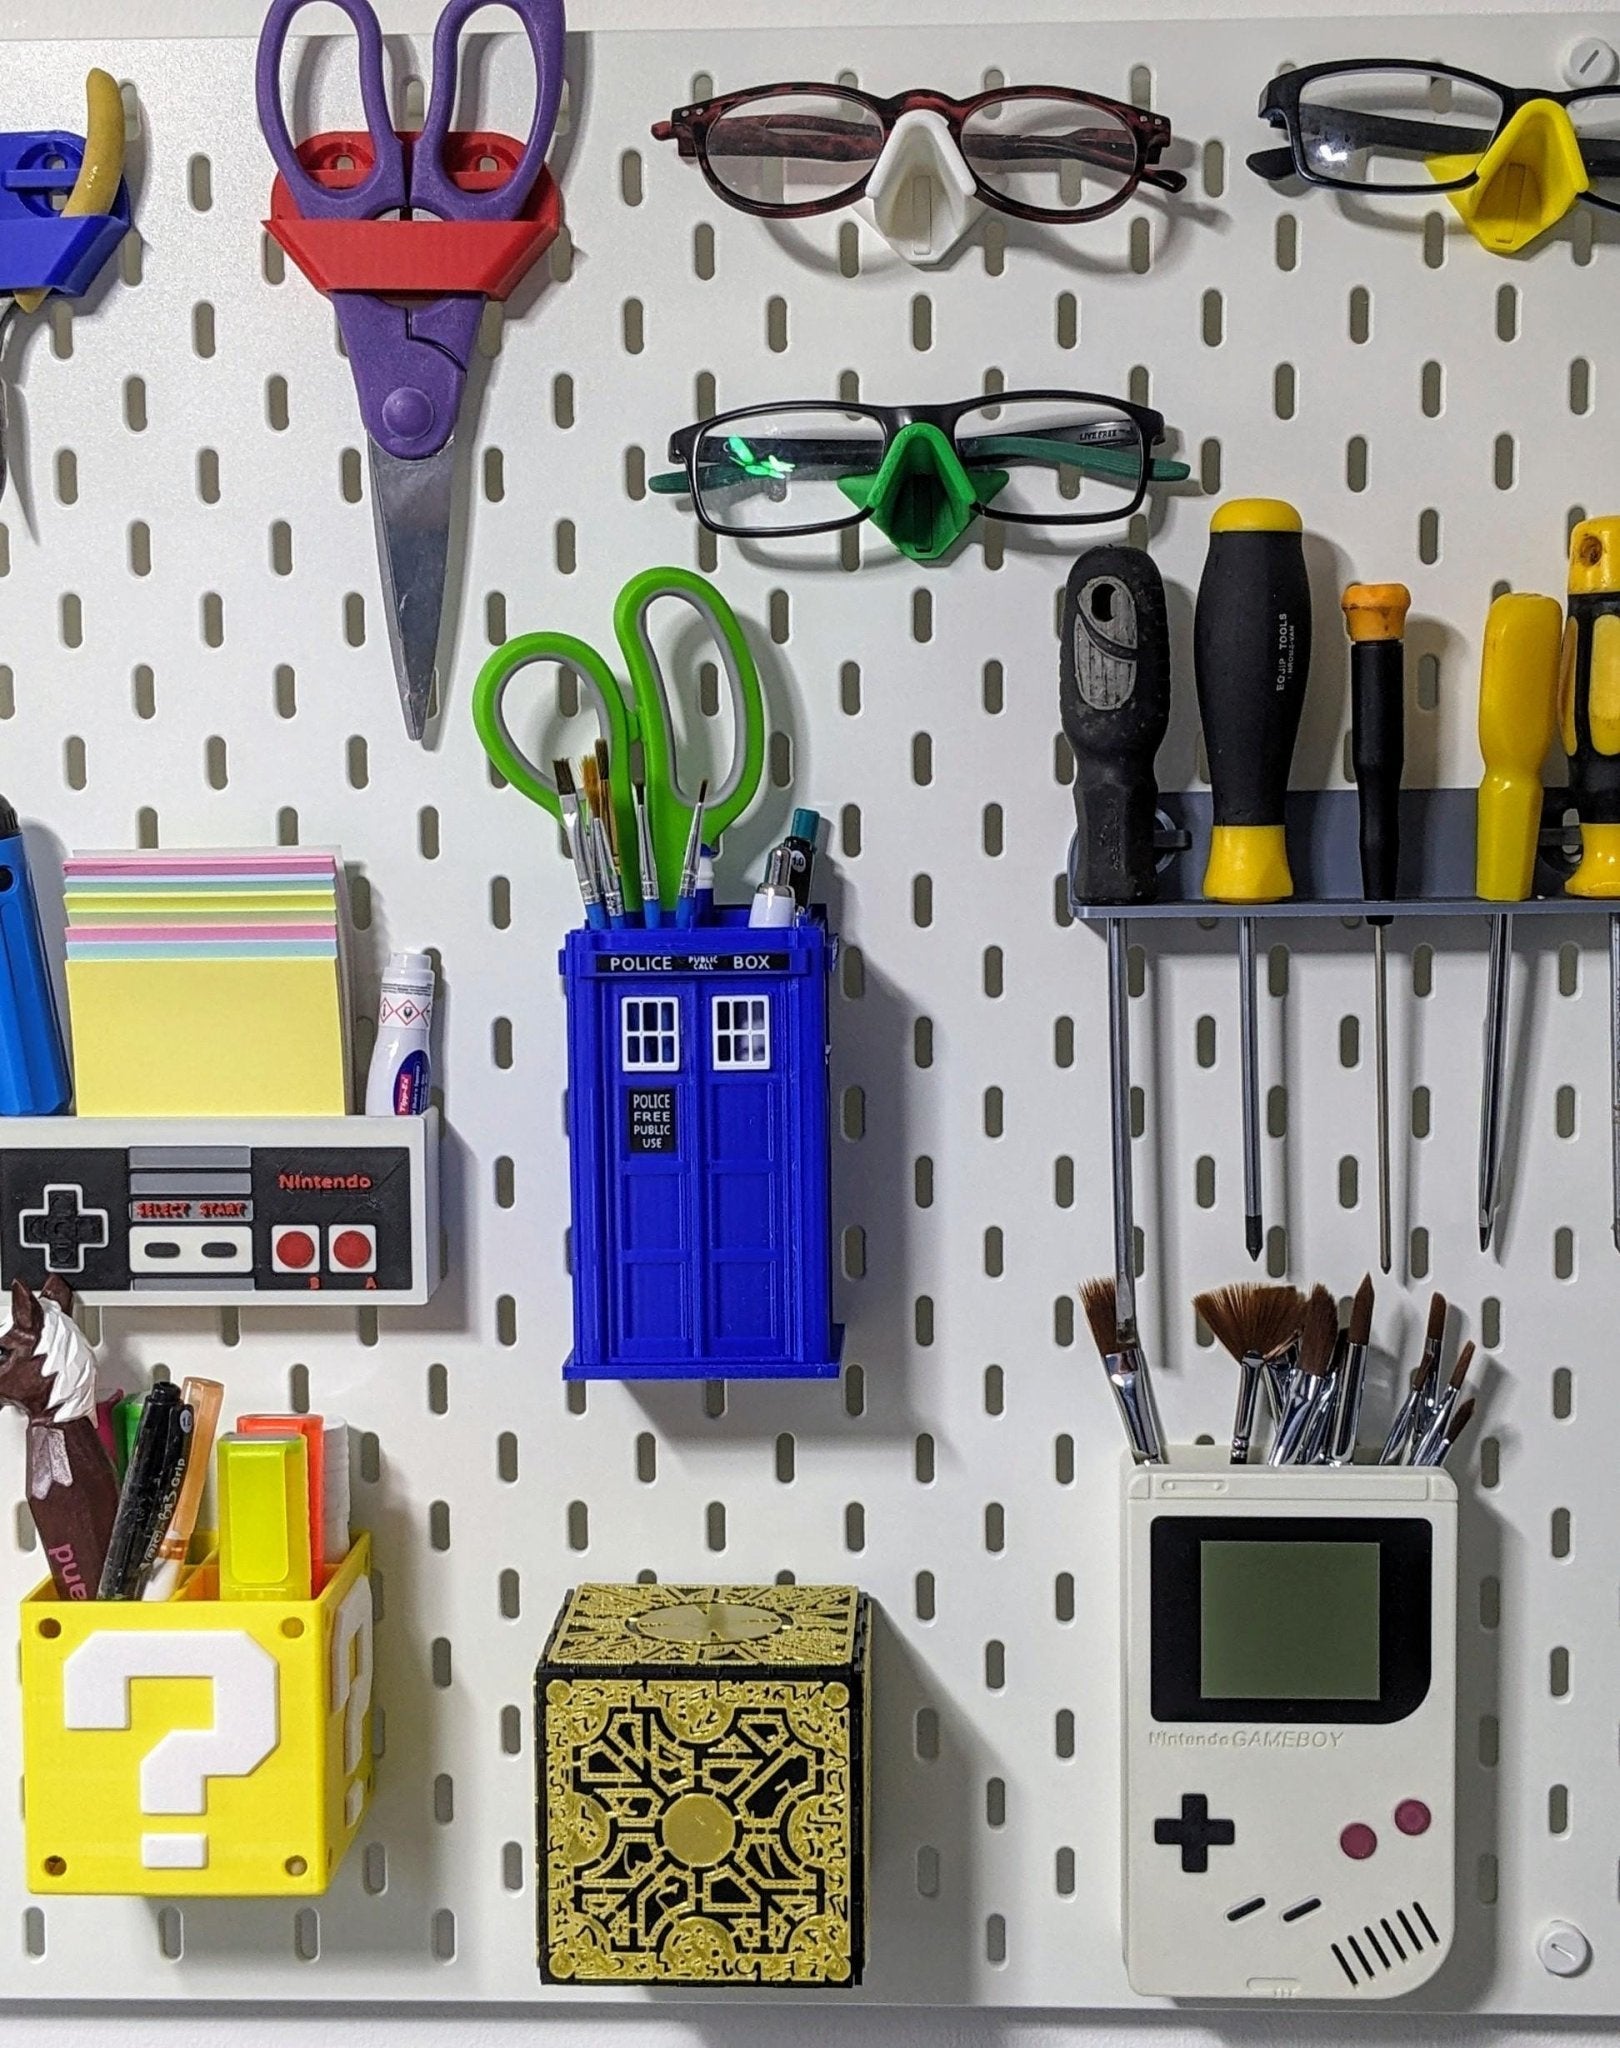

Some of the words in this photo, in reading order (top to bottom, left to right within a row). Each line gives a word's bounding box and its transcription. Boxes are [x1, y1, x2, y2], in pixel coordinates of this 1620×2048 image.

[1279, 613, 1288, 650] TOOLS
[610, 957, 672, 971] POLICE
[733, 955, 770, 969] BOX
[688, 954, 719, 964] PUBLIC
[693, 962, 714, 971] CALL
[633, 1093, 671, 1109] POLICE
[633, 1111, 671, 1122] FREE
[633, 1124, 671, 1136] PUBLIC
[642, 1137, 662, 1149] USE
[278, 1174, 372, 1190] Nintendo
[136, 1202, 190, 1218] SELECT
[200, 1202, 246, 1218] START
[309, 1276, 321, 1290] B
[366, 1276, 378, 1290] A
[171, 1458, 186, 1487] Grip
[1149, 1730, 1229, 1748] Nintendo
[1231, 1730, 1344, 1748] GAMEBOY
